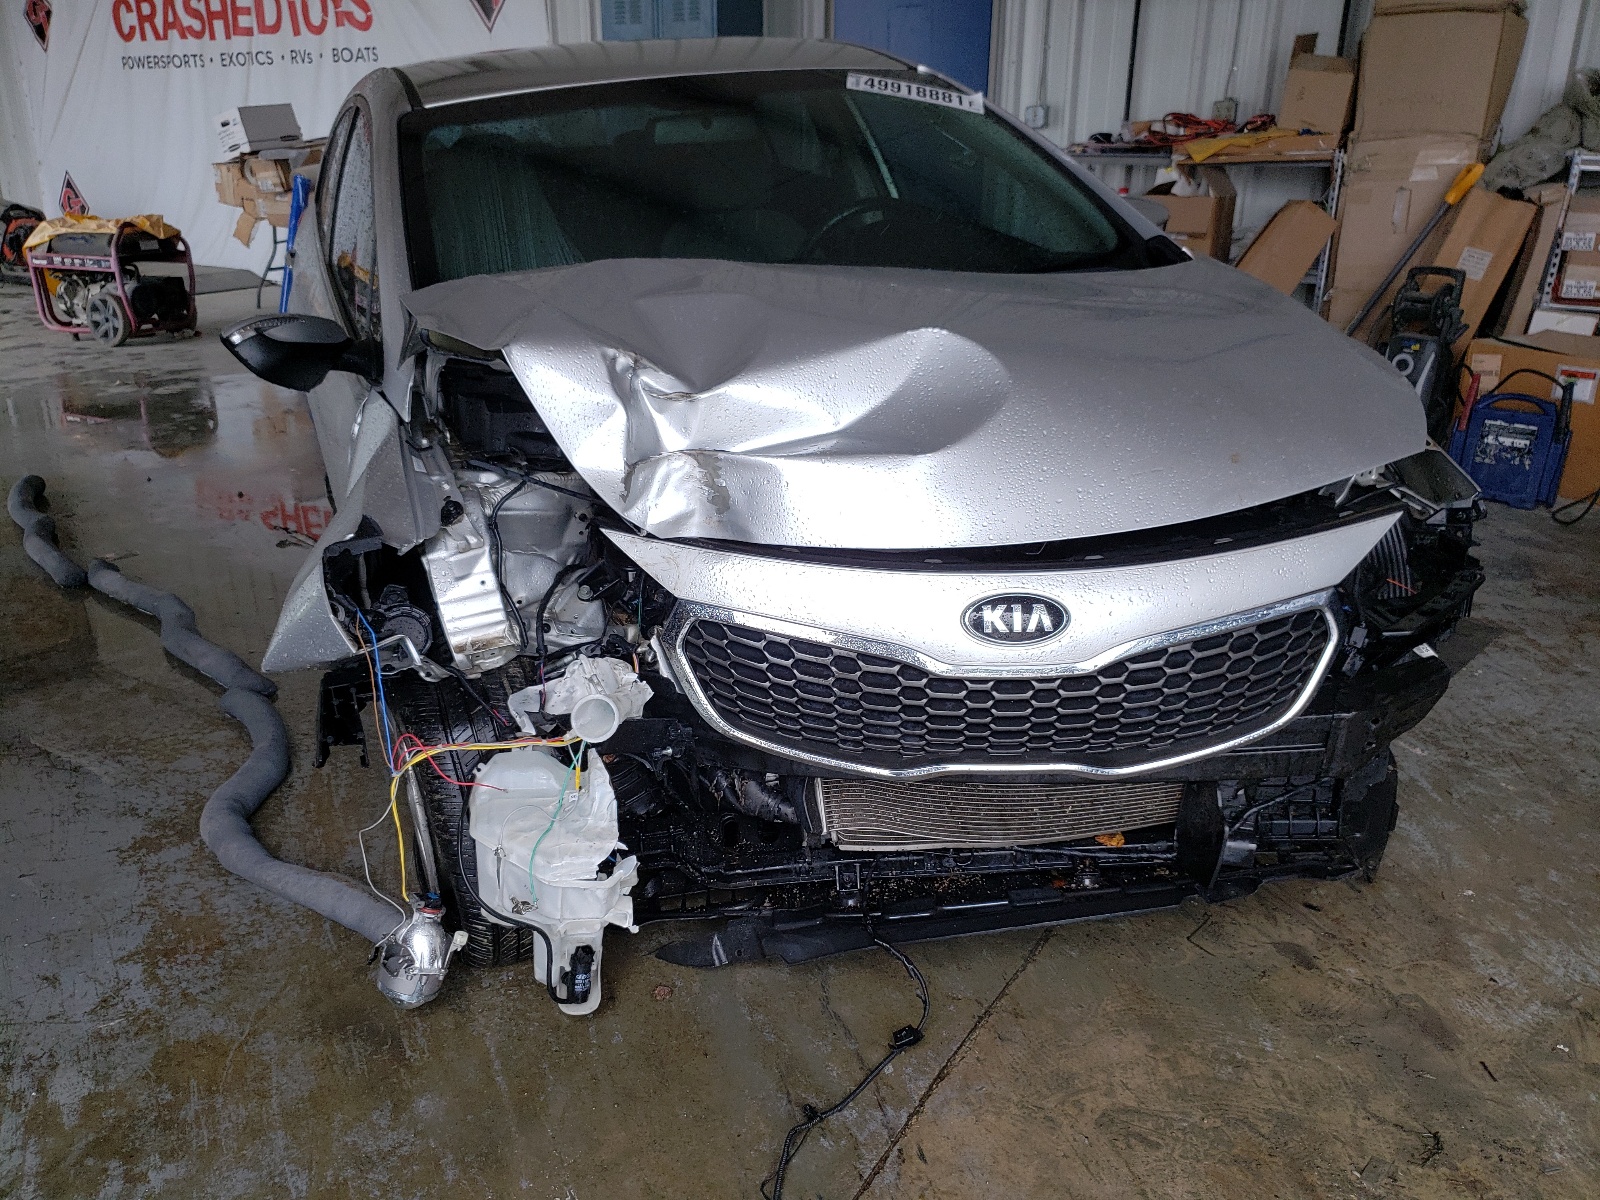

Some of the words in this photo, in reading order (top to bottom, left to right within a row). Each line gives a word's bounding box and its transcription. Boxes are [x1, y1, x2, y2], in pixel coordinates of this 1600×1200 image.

[121, 54, 205, 70] POWERSPORTS
[220, 51, 274, 66] EXOTICS
[289, 49, 314, 64] RVs
[332, 46, 379, 63] BOATS
[863, 77, 963, 107] 49918881
[981, 603, 1053, 633] KIA
